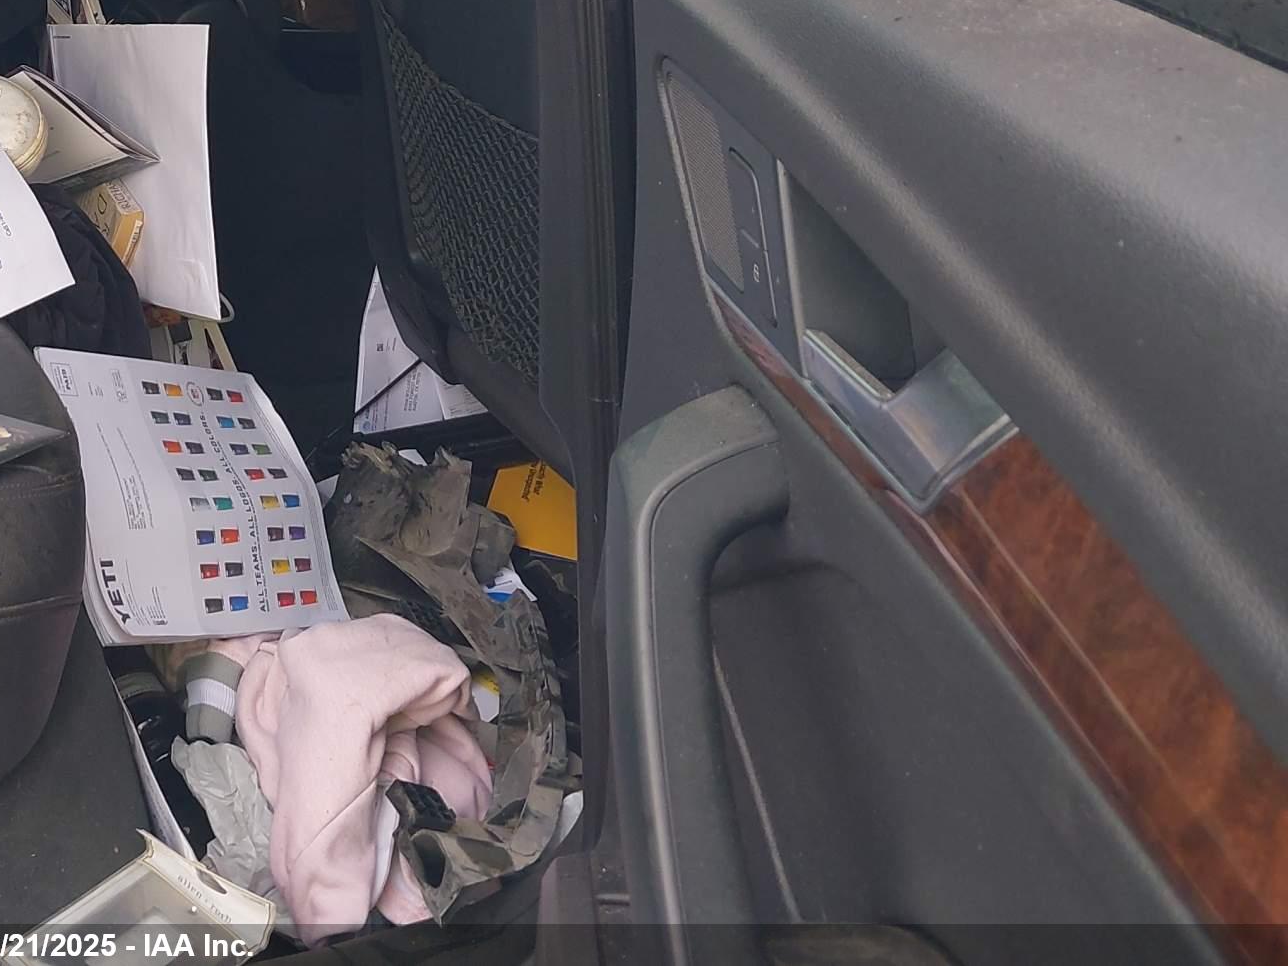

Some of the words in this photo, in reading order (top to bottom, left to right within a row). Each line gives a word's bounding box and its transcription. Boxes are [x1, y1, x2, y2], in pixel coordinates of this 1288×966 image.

[199, 411, 221, 453] COLORS.
[218, 455, 233, 474] ALL
[231, 474, 252, 513] LOGOS.
[246, 515, 256, 539] ALL
[250, 542, 263, 586] TEAMS.
[100, 559, 131, 625] YETI
[257, 588, 267, 613] ALL
